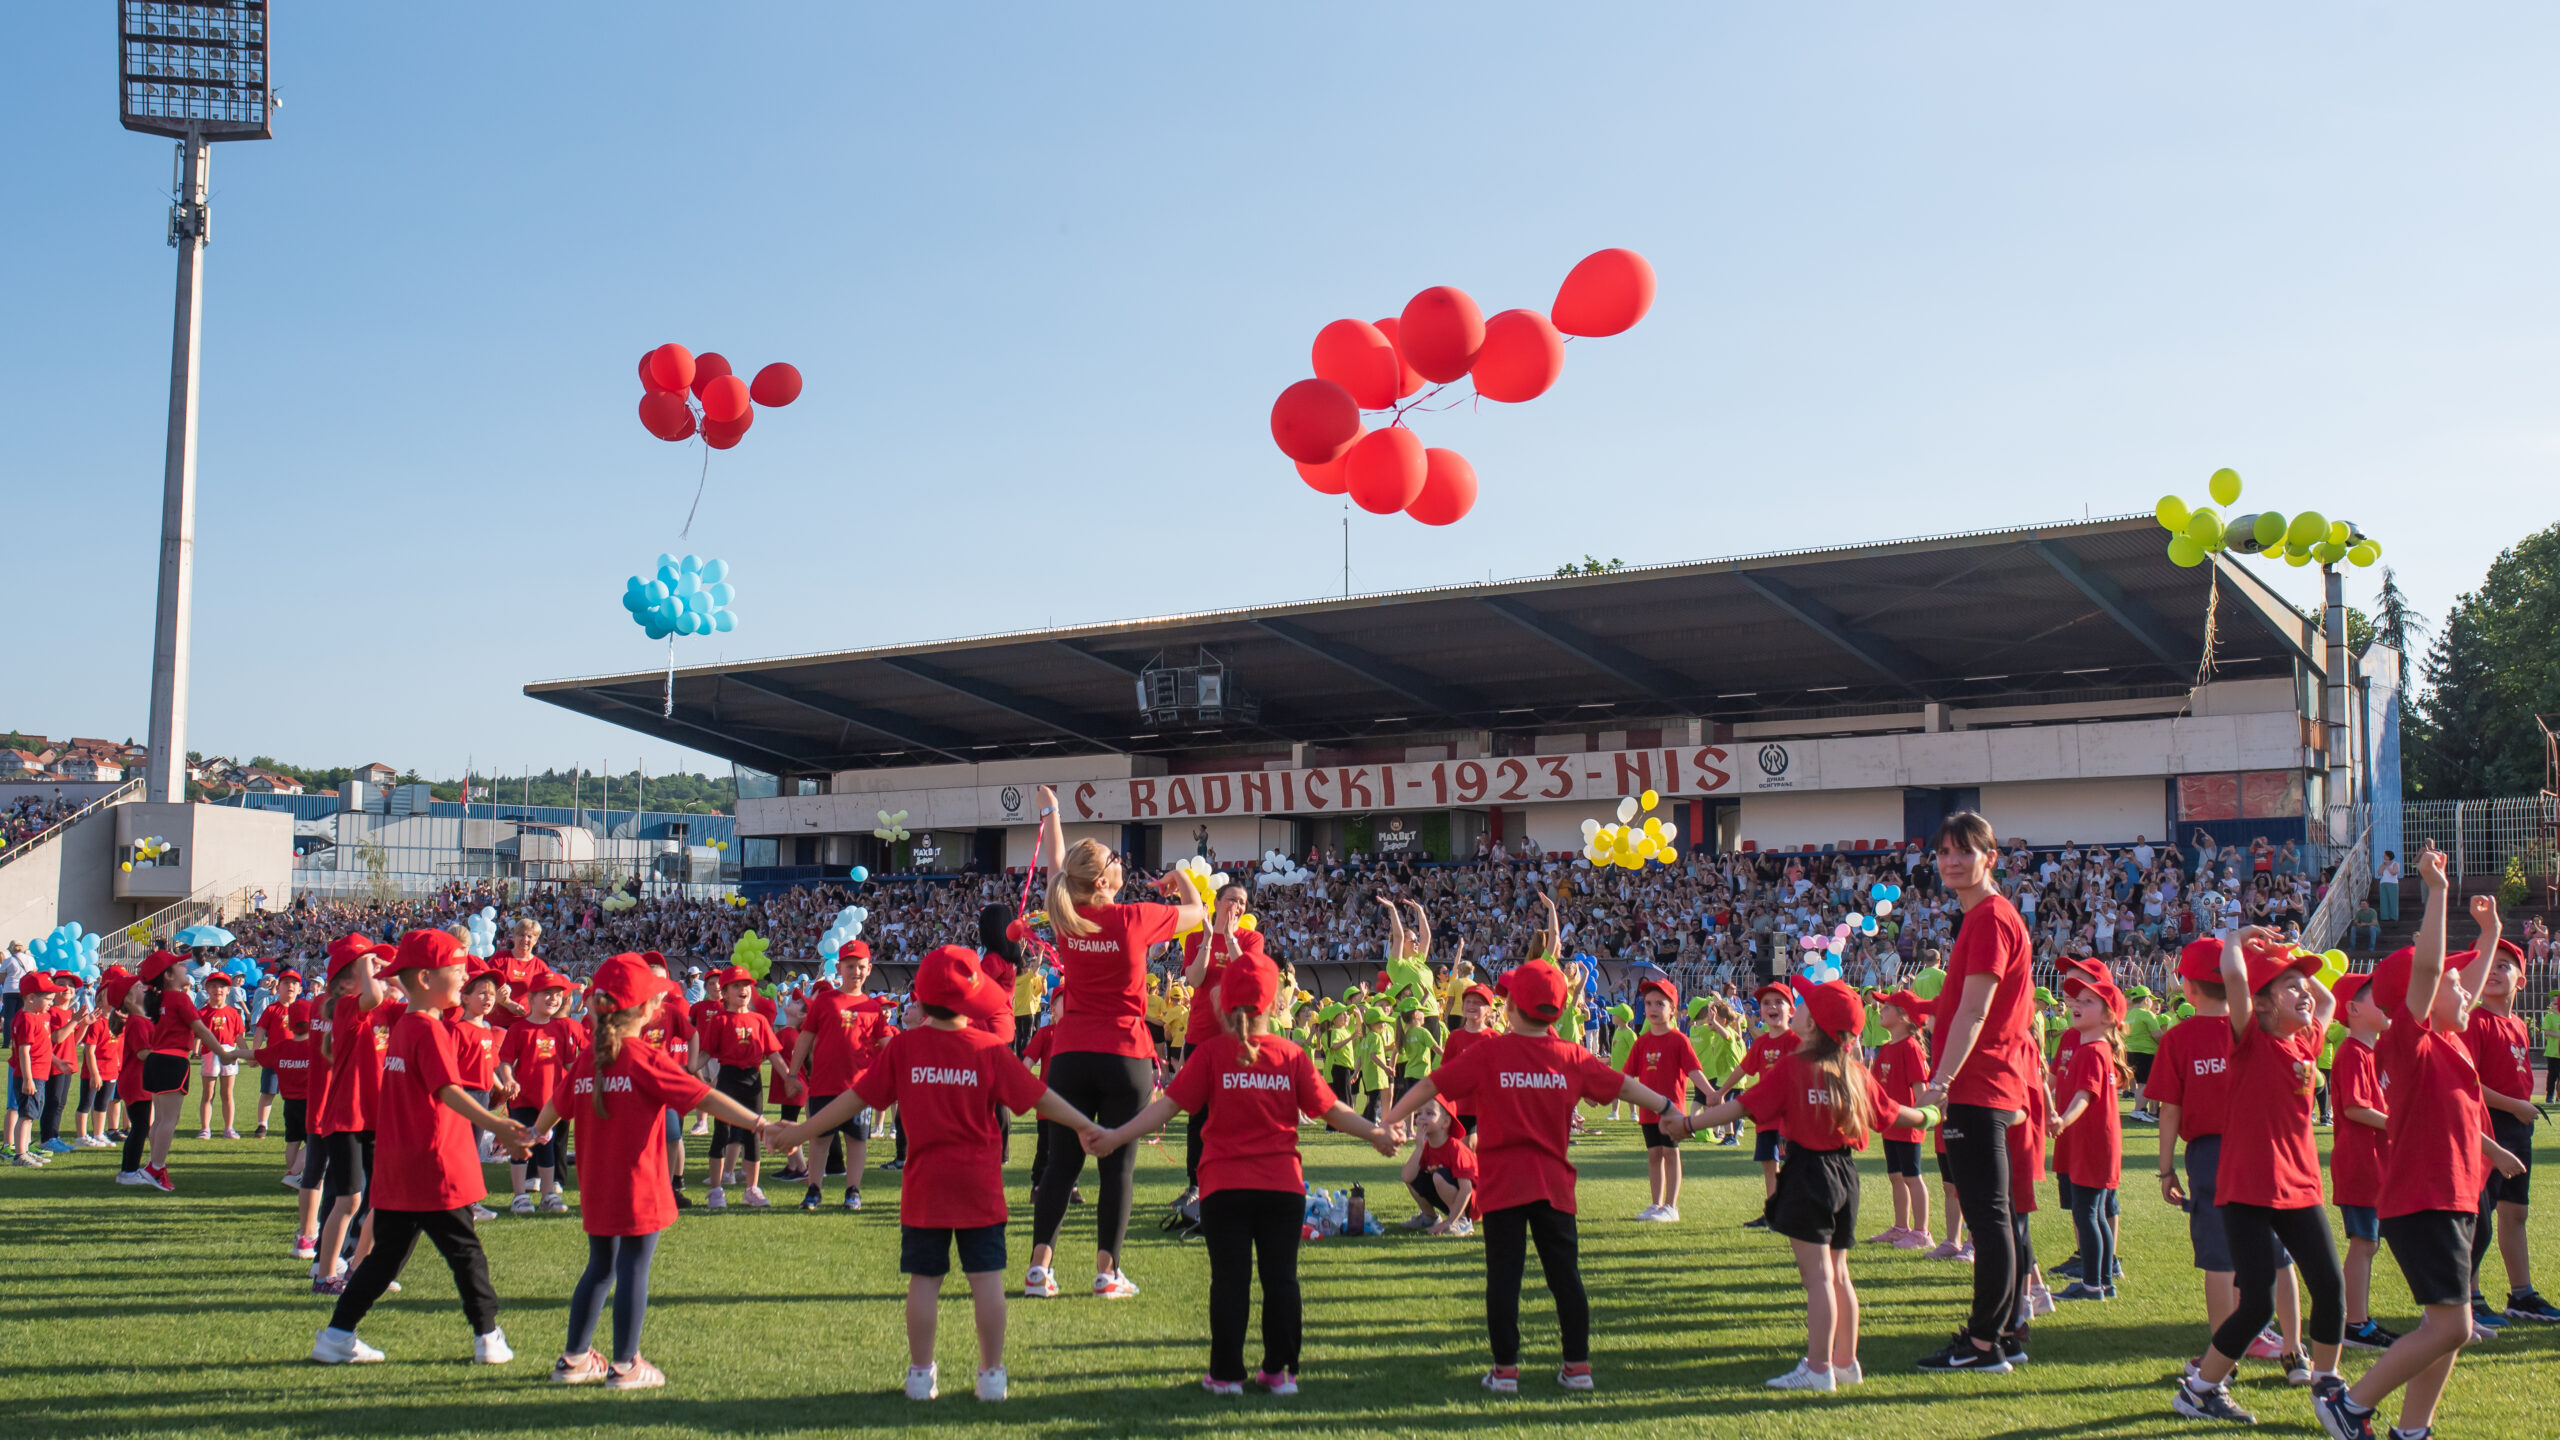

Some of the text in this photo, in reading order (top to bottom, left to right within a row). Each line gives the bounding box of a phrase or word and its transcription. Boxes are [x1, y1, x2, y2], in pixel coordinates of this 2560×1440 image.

[1067, 937, 1120, 953] БУБАМАРА
[2193, 1057, 2227, 1076] БУБА
[574, 1075, 633, 1095] БУБМАРА
[911, 1066, 978, 1087] БУБАМАРА
[1222, 1072, 1291, 1092] БУБАМАРА
[1499, 1071, 1568, 1090] БУБАМАРА
